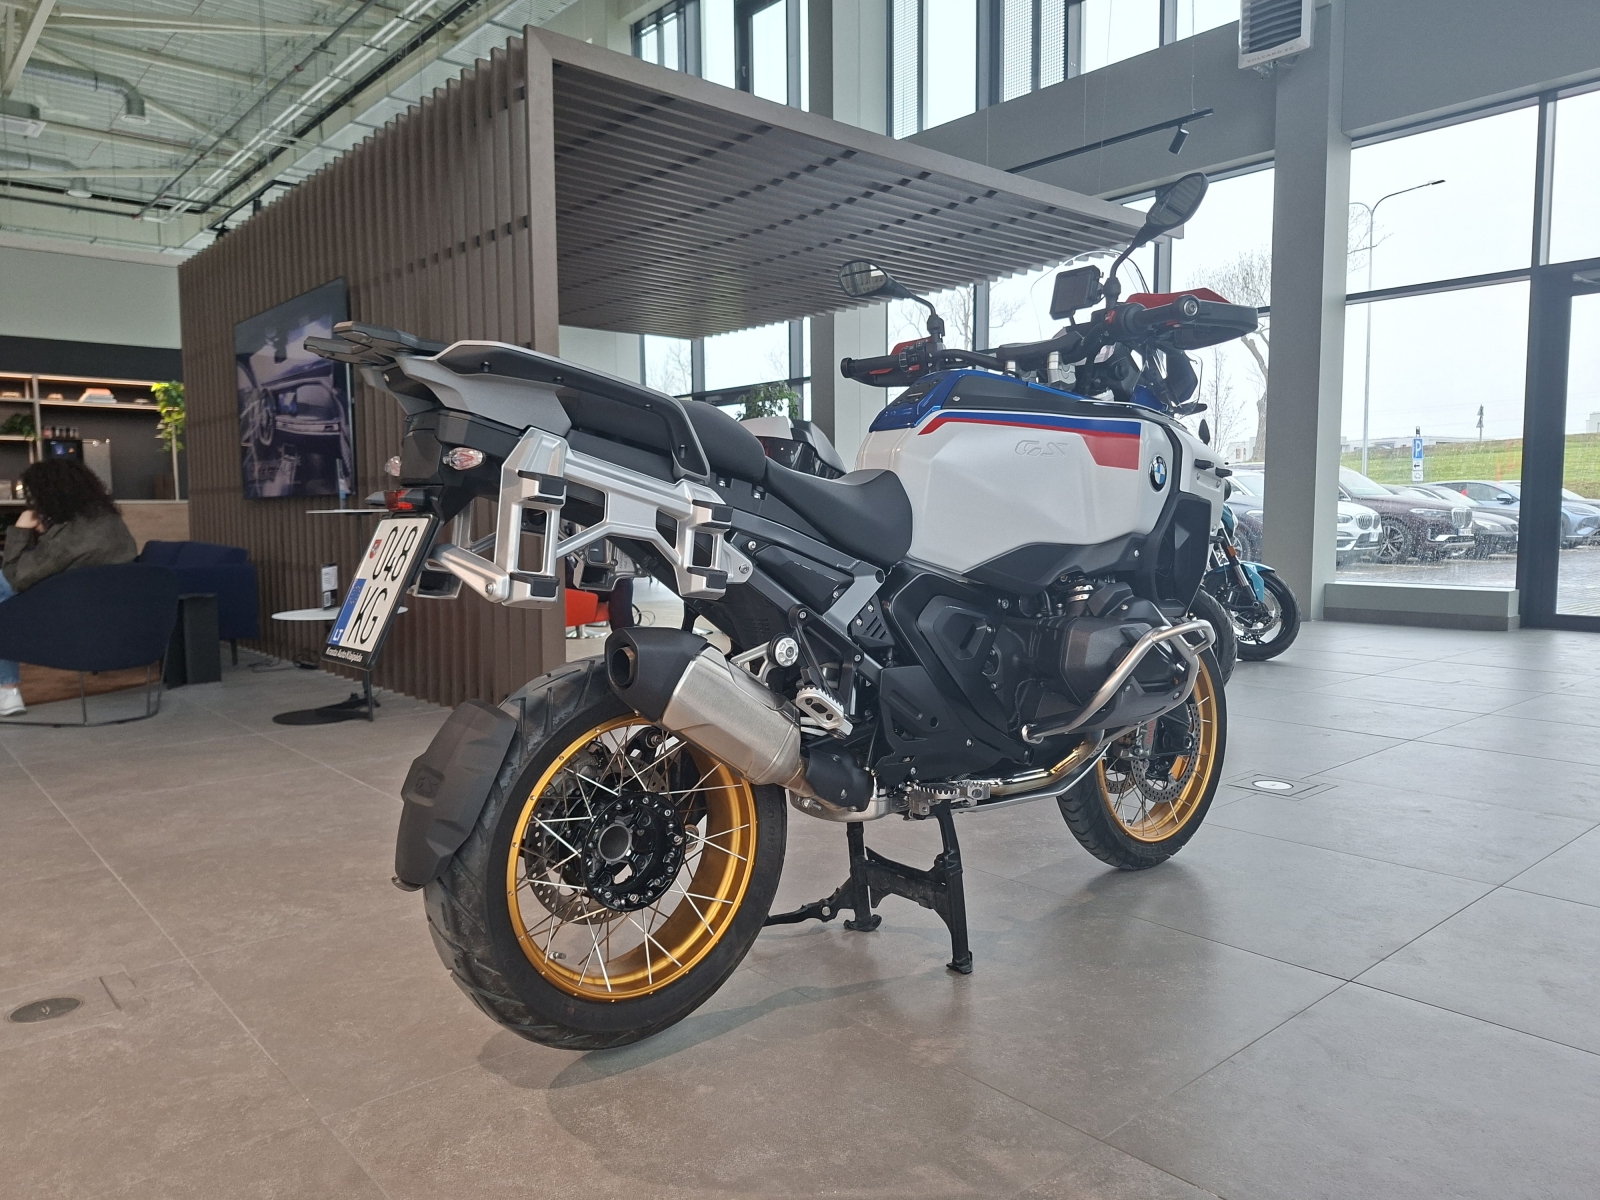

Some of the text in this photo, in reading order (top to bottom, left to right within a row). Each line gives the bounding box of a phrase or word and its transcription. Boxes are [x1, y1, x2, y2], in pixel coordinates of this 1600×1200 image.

[1014, 439, 1069, 459] GS
[1415, 439, 1422, 458] P
[372, 526, 419, 582] 048
[346, 585, 388, 645] KG
[332, 628, 344, 642] LT
